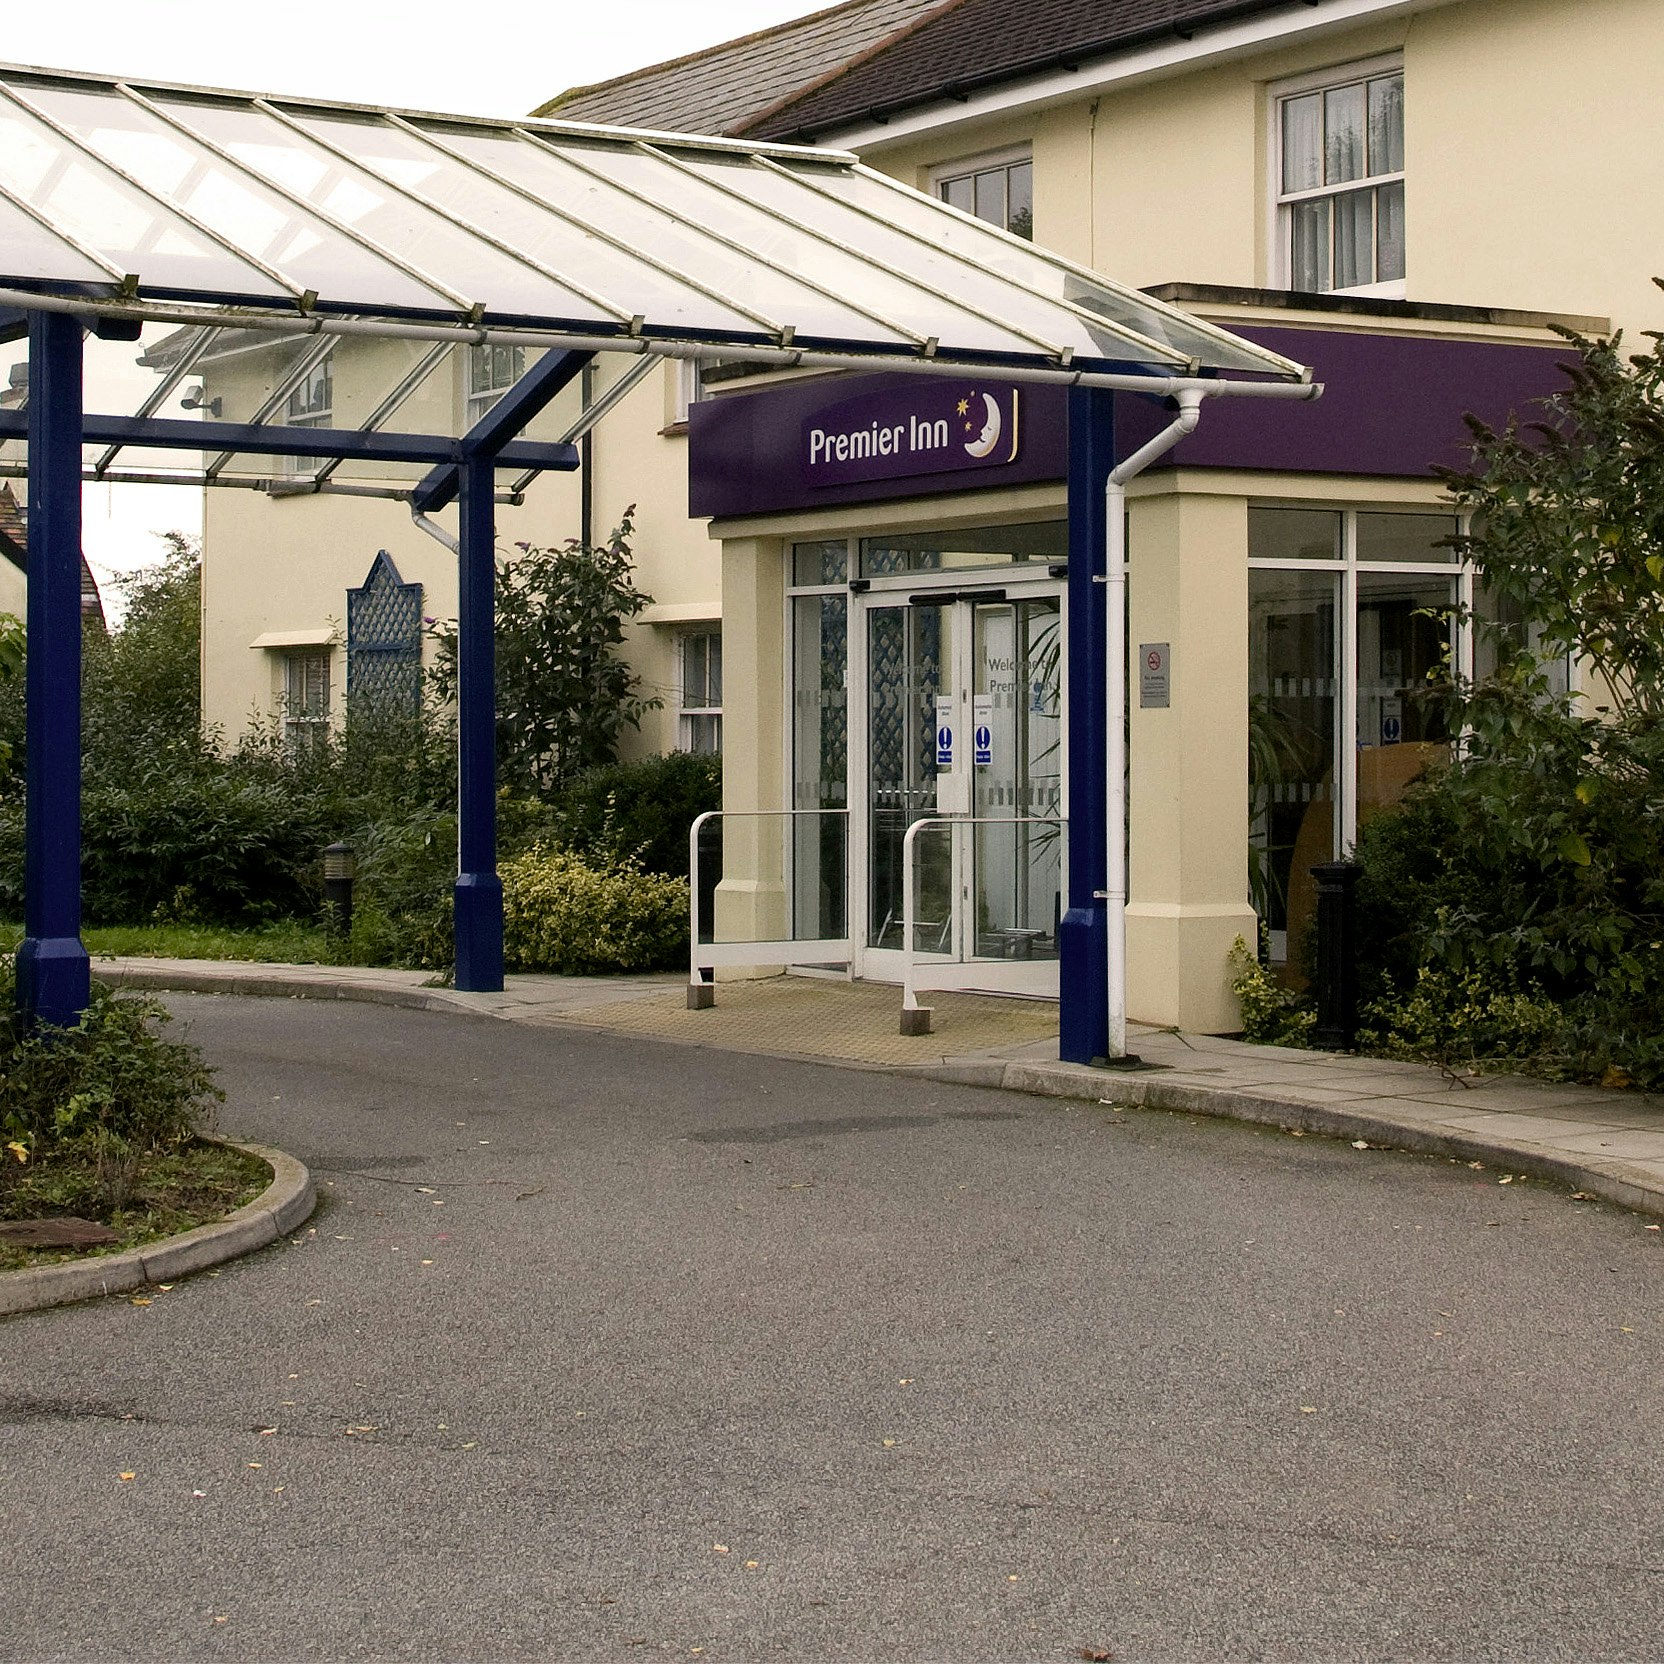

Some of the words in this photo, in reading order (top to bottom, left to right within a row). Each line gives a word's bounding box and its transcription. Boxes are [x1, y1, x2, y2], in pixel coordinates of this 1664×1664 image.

[810, 421, 905, 465] Premier
[910, 415, 949, 451] Inn
[988, 658, 1038, 672] Welce
[989, 679, 1033, 693] Prem
